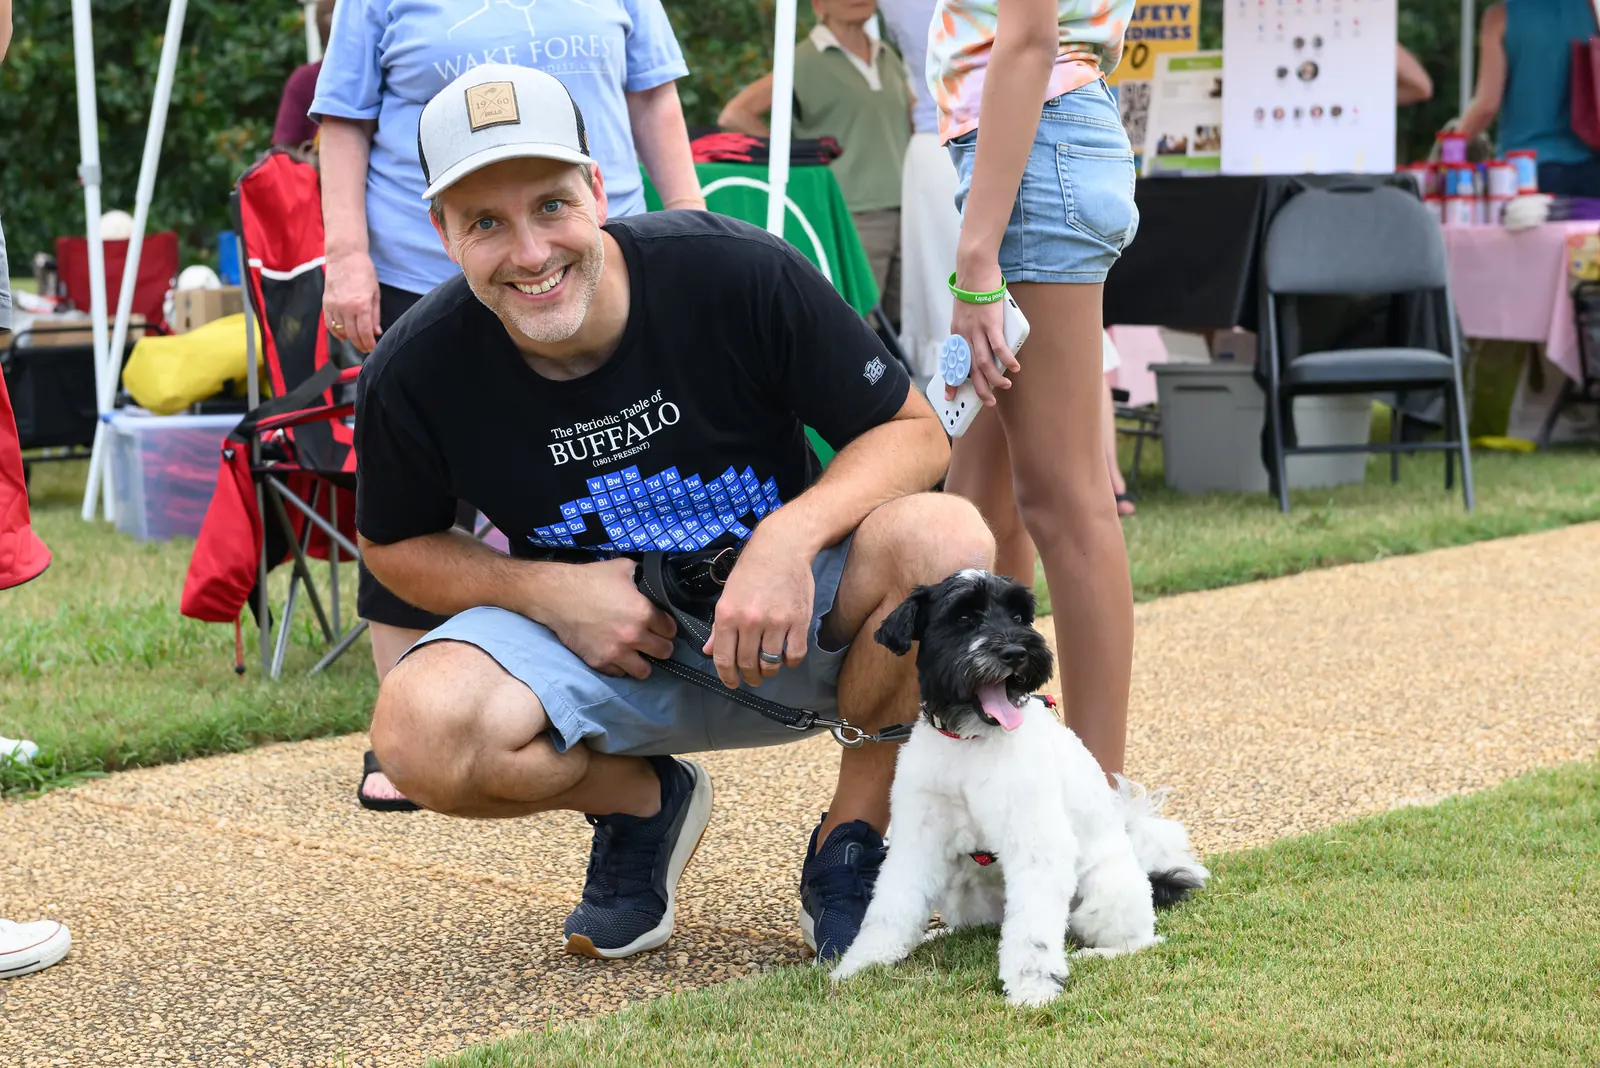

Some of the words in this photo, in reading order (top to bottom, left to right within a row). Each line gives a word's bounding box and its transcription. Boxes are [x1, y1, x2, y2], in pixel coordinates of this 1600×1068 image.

[432, 45, 516, 80] WAKE
[529, 34, 617, 63] FOREST
[476, 101, 486, 110] 19
[497, 97, 509, 105] 60
[548, 402, 680, 466] BUFFALO
[550, 427, 573, 439] The
[574, 415, 620, 434] Periodic
[620, 399, 650, 420] Table
[650, 389, 663, 403] of
[592, 441, 650, 468] (1801-PRESENT)
